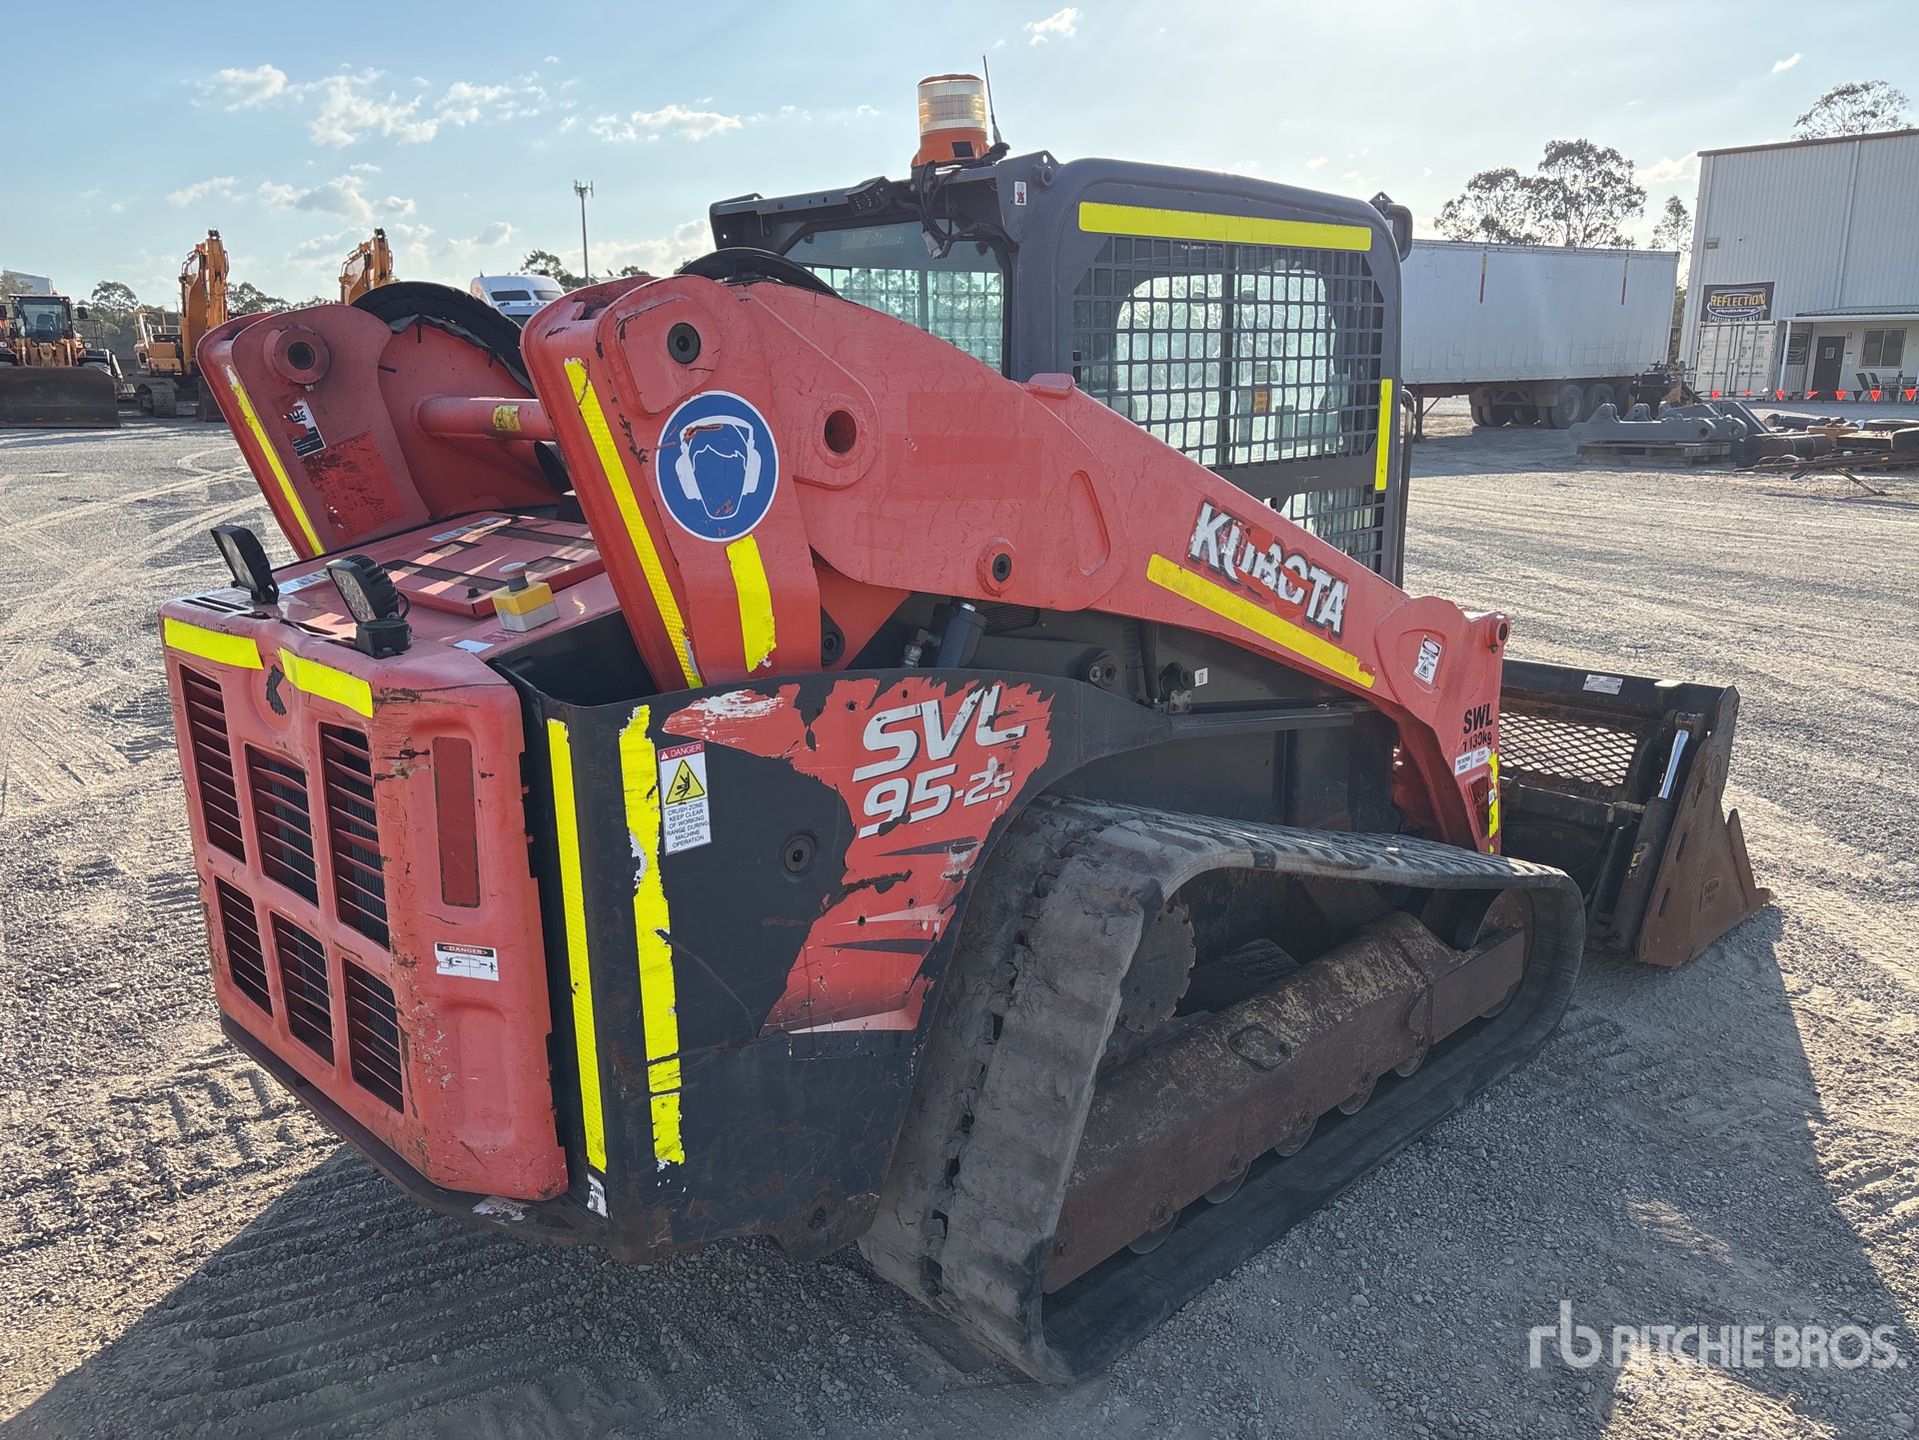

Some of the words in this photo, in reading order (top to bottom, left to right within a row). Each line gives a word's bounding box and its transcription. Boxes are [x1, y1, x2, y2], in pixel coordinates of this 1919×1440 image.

[1711, 294, 1765, 306] REFLECTION
[1188, 501, 1349, 635] KUBOTA
[1463, 703, 1493, 735] SWL
[852, 685, 1027, 782] SVL
[670, 743, 702, 758] DANGER
[668, 804, 688, 816] CRUSH
[689, 801, 704, 811] ZONE
[669, 813, 684, 822] KEEP
[685, 808, 704, 818] CLEAR
[666, 826, 686, 836] RANGE
[687, 820, 709, 831] DURING
[668, 822, 678, 830] OF
[678, 815, 705, 827] WORKING
[672, 834, 705, 848] OPERATION
[675, 829, 701, 841] MACHINE
[449, 946, 482, 954] DANGER
